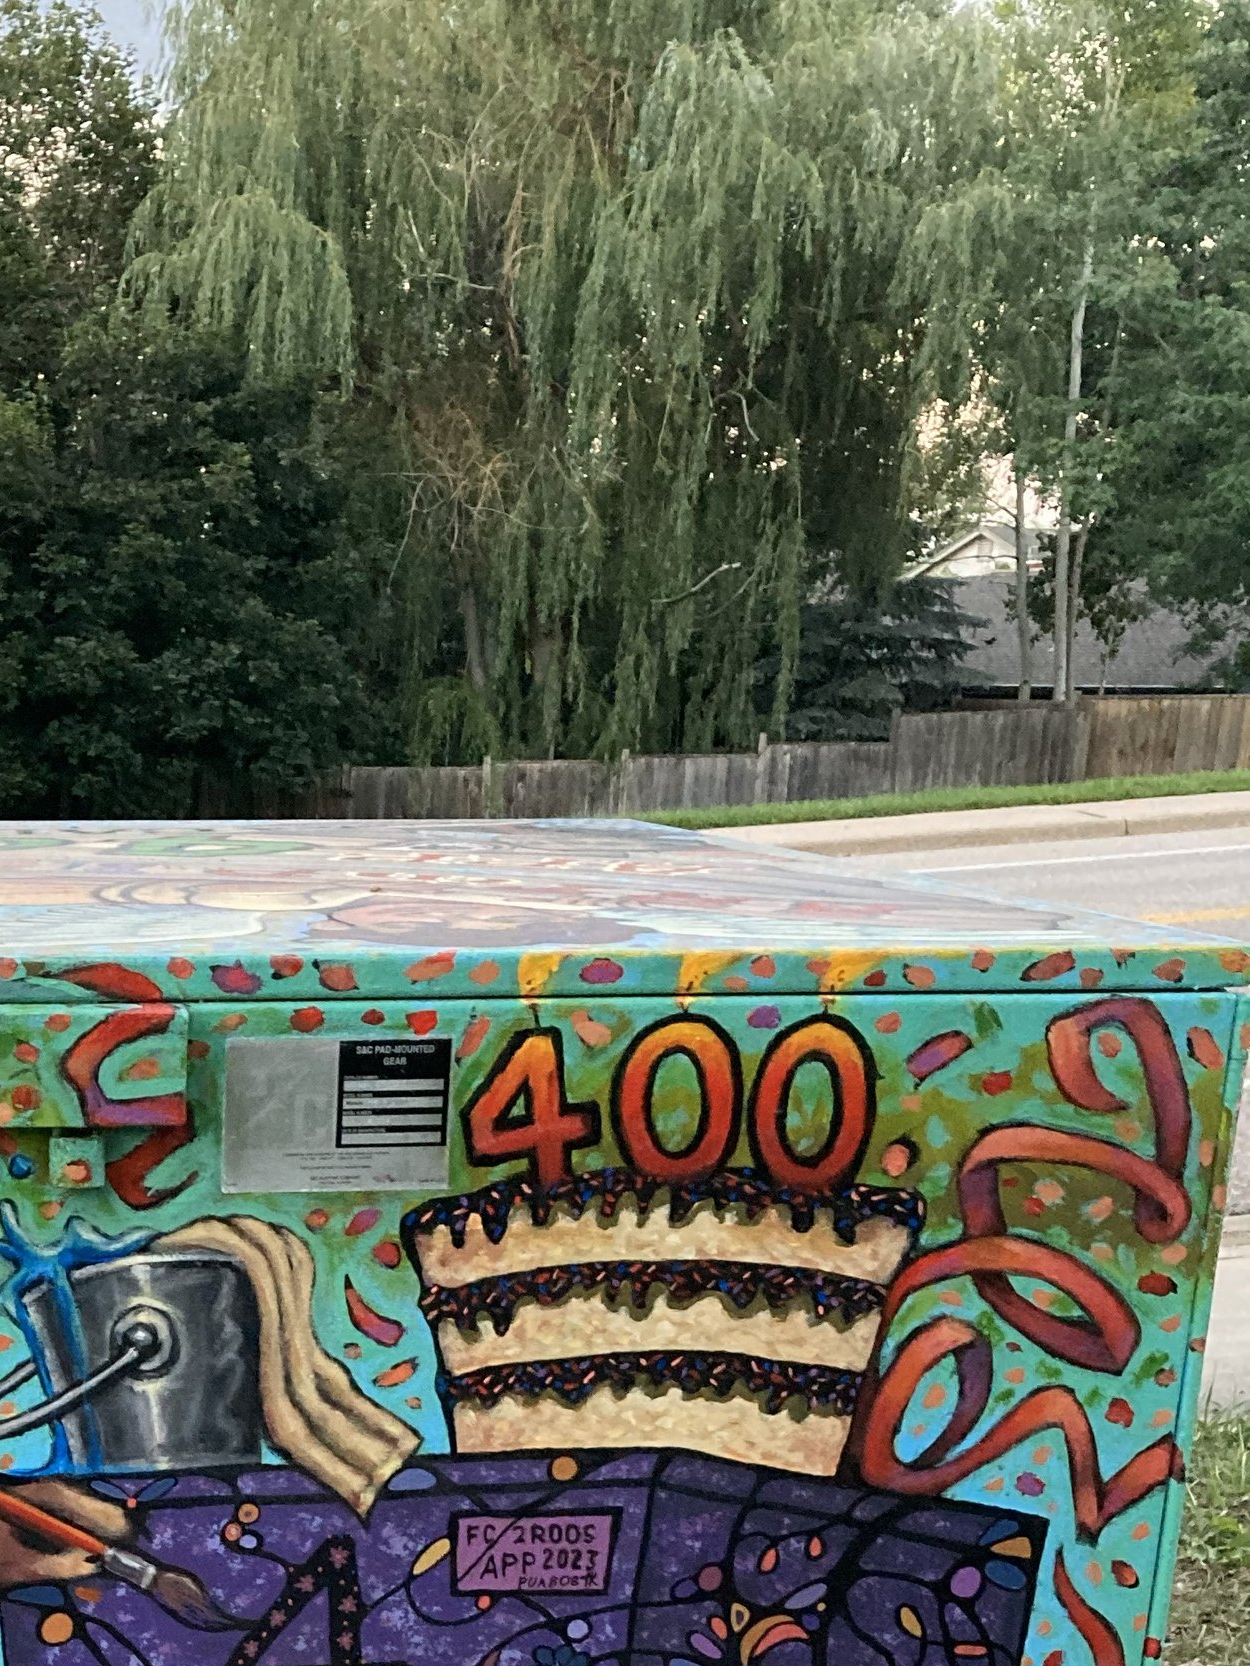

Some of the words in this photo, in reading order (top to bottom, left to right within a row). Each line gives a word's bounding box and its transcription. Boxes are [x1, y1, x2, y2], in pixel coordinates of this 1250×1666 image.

[356, 1045, 374, 1055] S&C
[375, 1044, 436, 1055] PAD-MOUNTED
[383, 1056, 408, 1066] GEAR
[461, 1012, 878, 1192] 400
